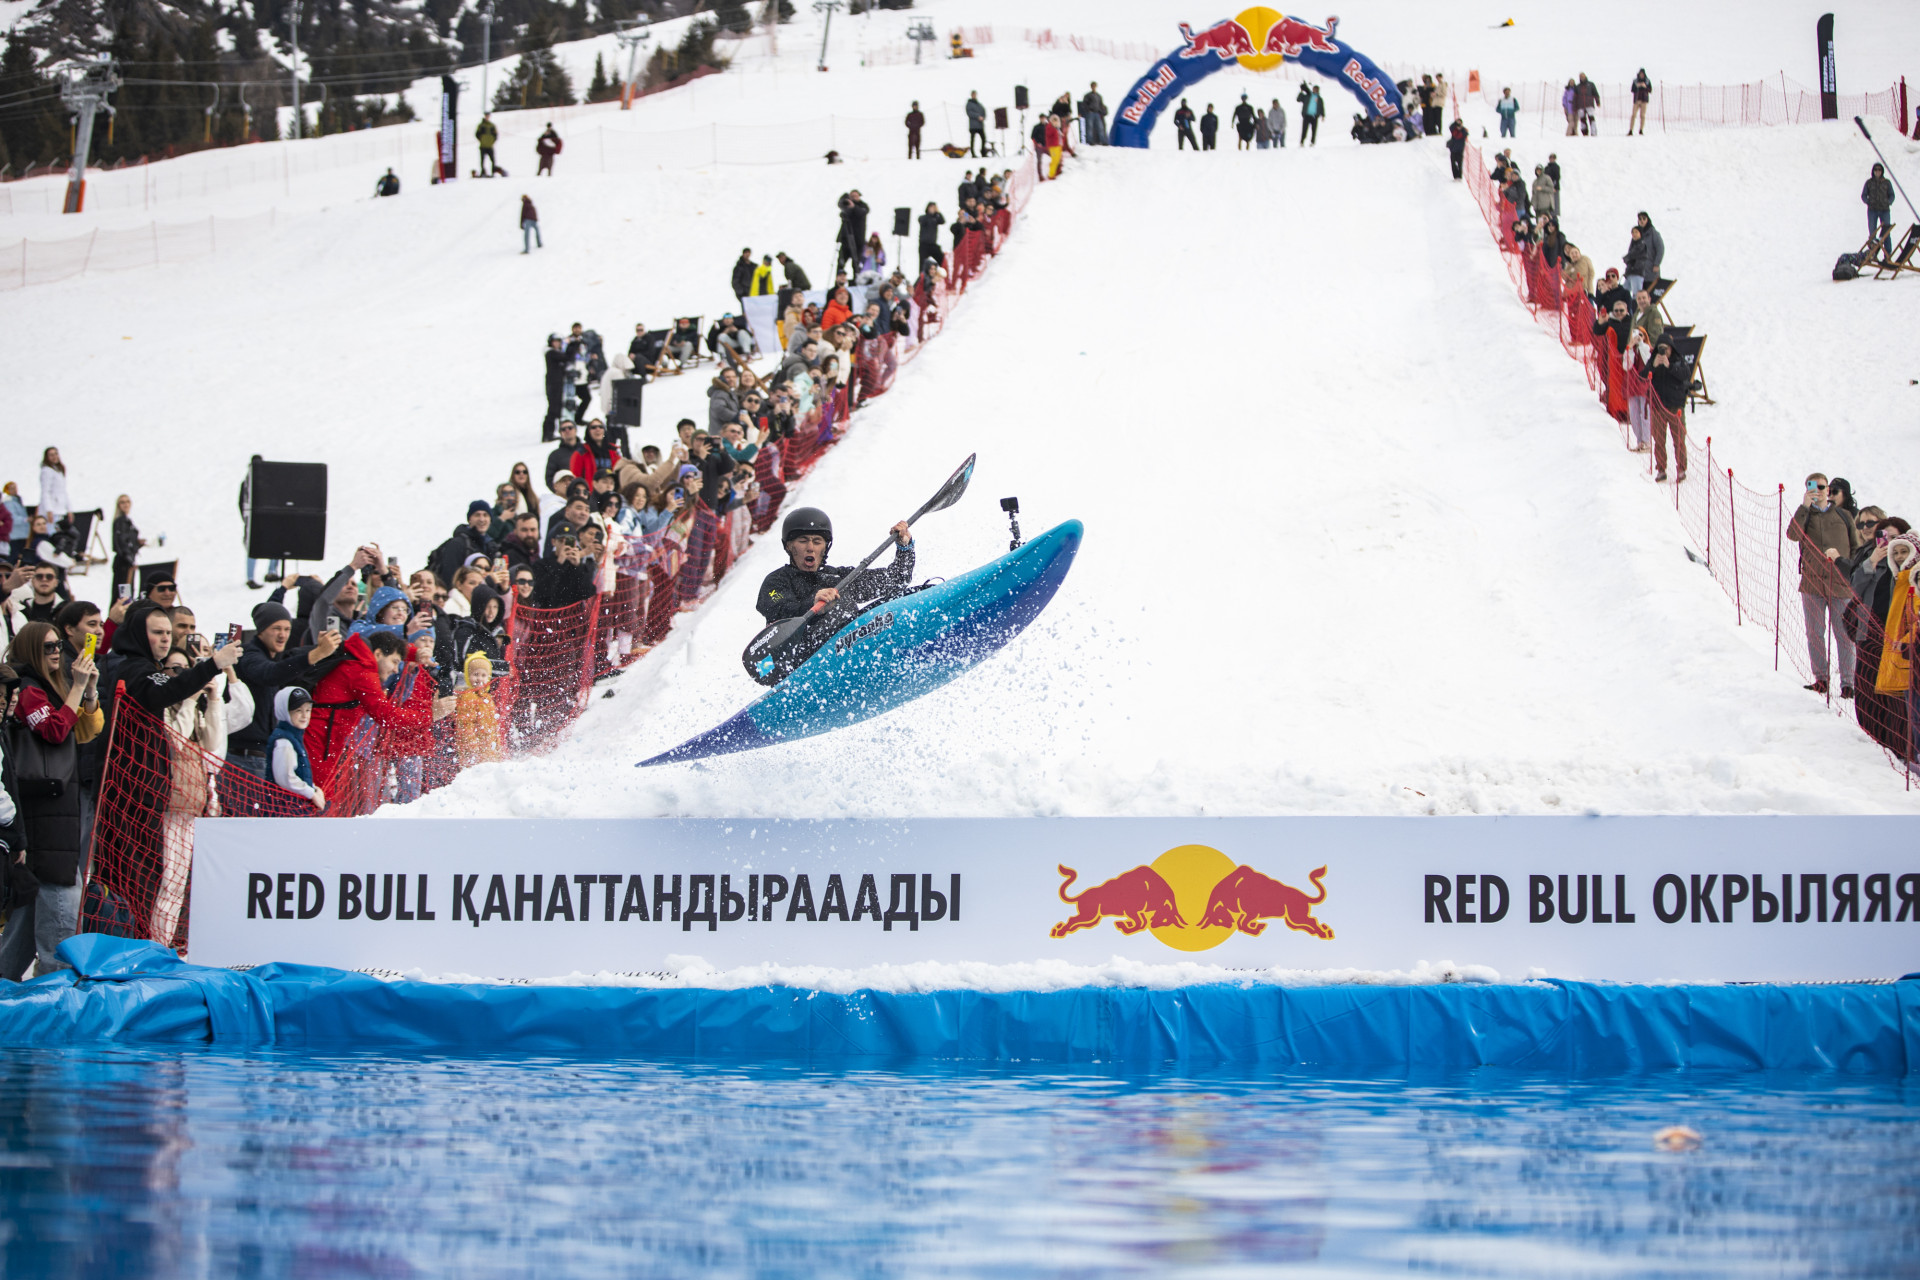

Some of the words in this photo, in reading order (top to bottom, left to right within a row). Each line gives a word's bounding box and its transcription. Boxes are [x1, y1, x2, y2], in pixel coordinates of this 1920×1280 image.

[1122, 87, 1154, 125] Red
[1142, 63, 1177, 99] Bull
[1342, 57, 1379, 93] Red
[1369, 84, 1400, 119] Bull
[750, 626, 779, 655] galasport
[834, 611, 895, 656] pyranha
[247, 873, 325, 920] RED
[338, 874, 436, 921] BULL
[452, 873, 961, 932] ҚАНАТТАНДЫРАААДЫ
[1424, 874, 1510, 924] RED
[1529, 874, 1636, 924] BULL
[1652, 873, 1920, 924] ОКРЫЛЯЯЯ
